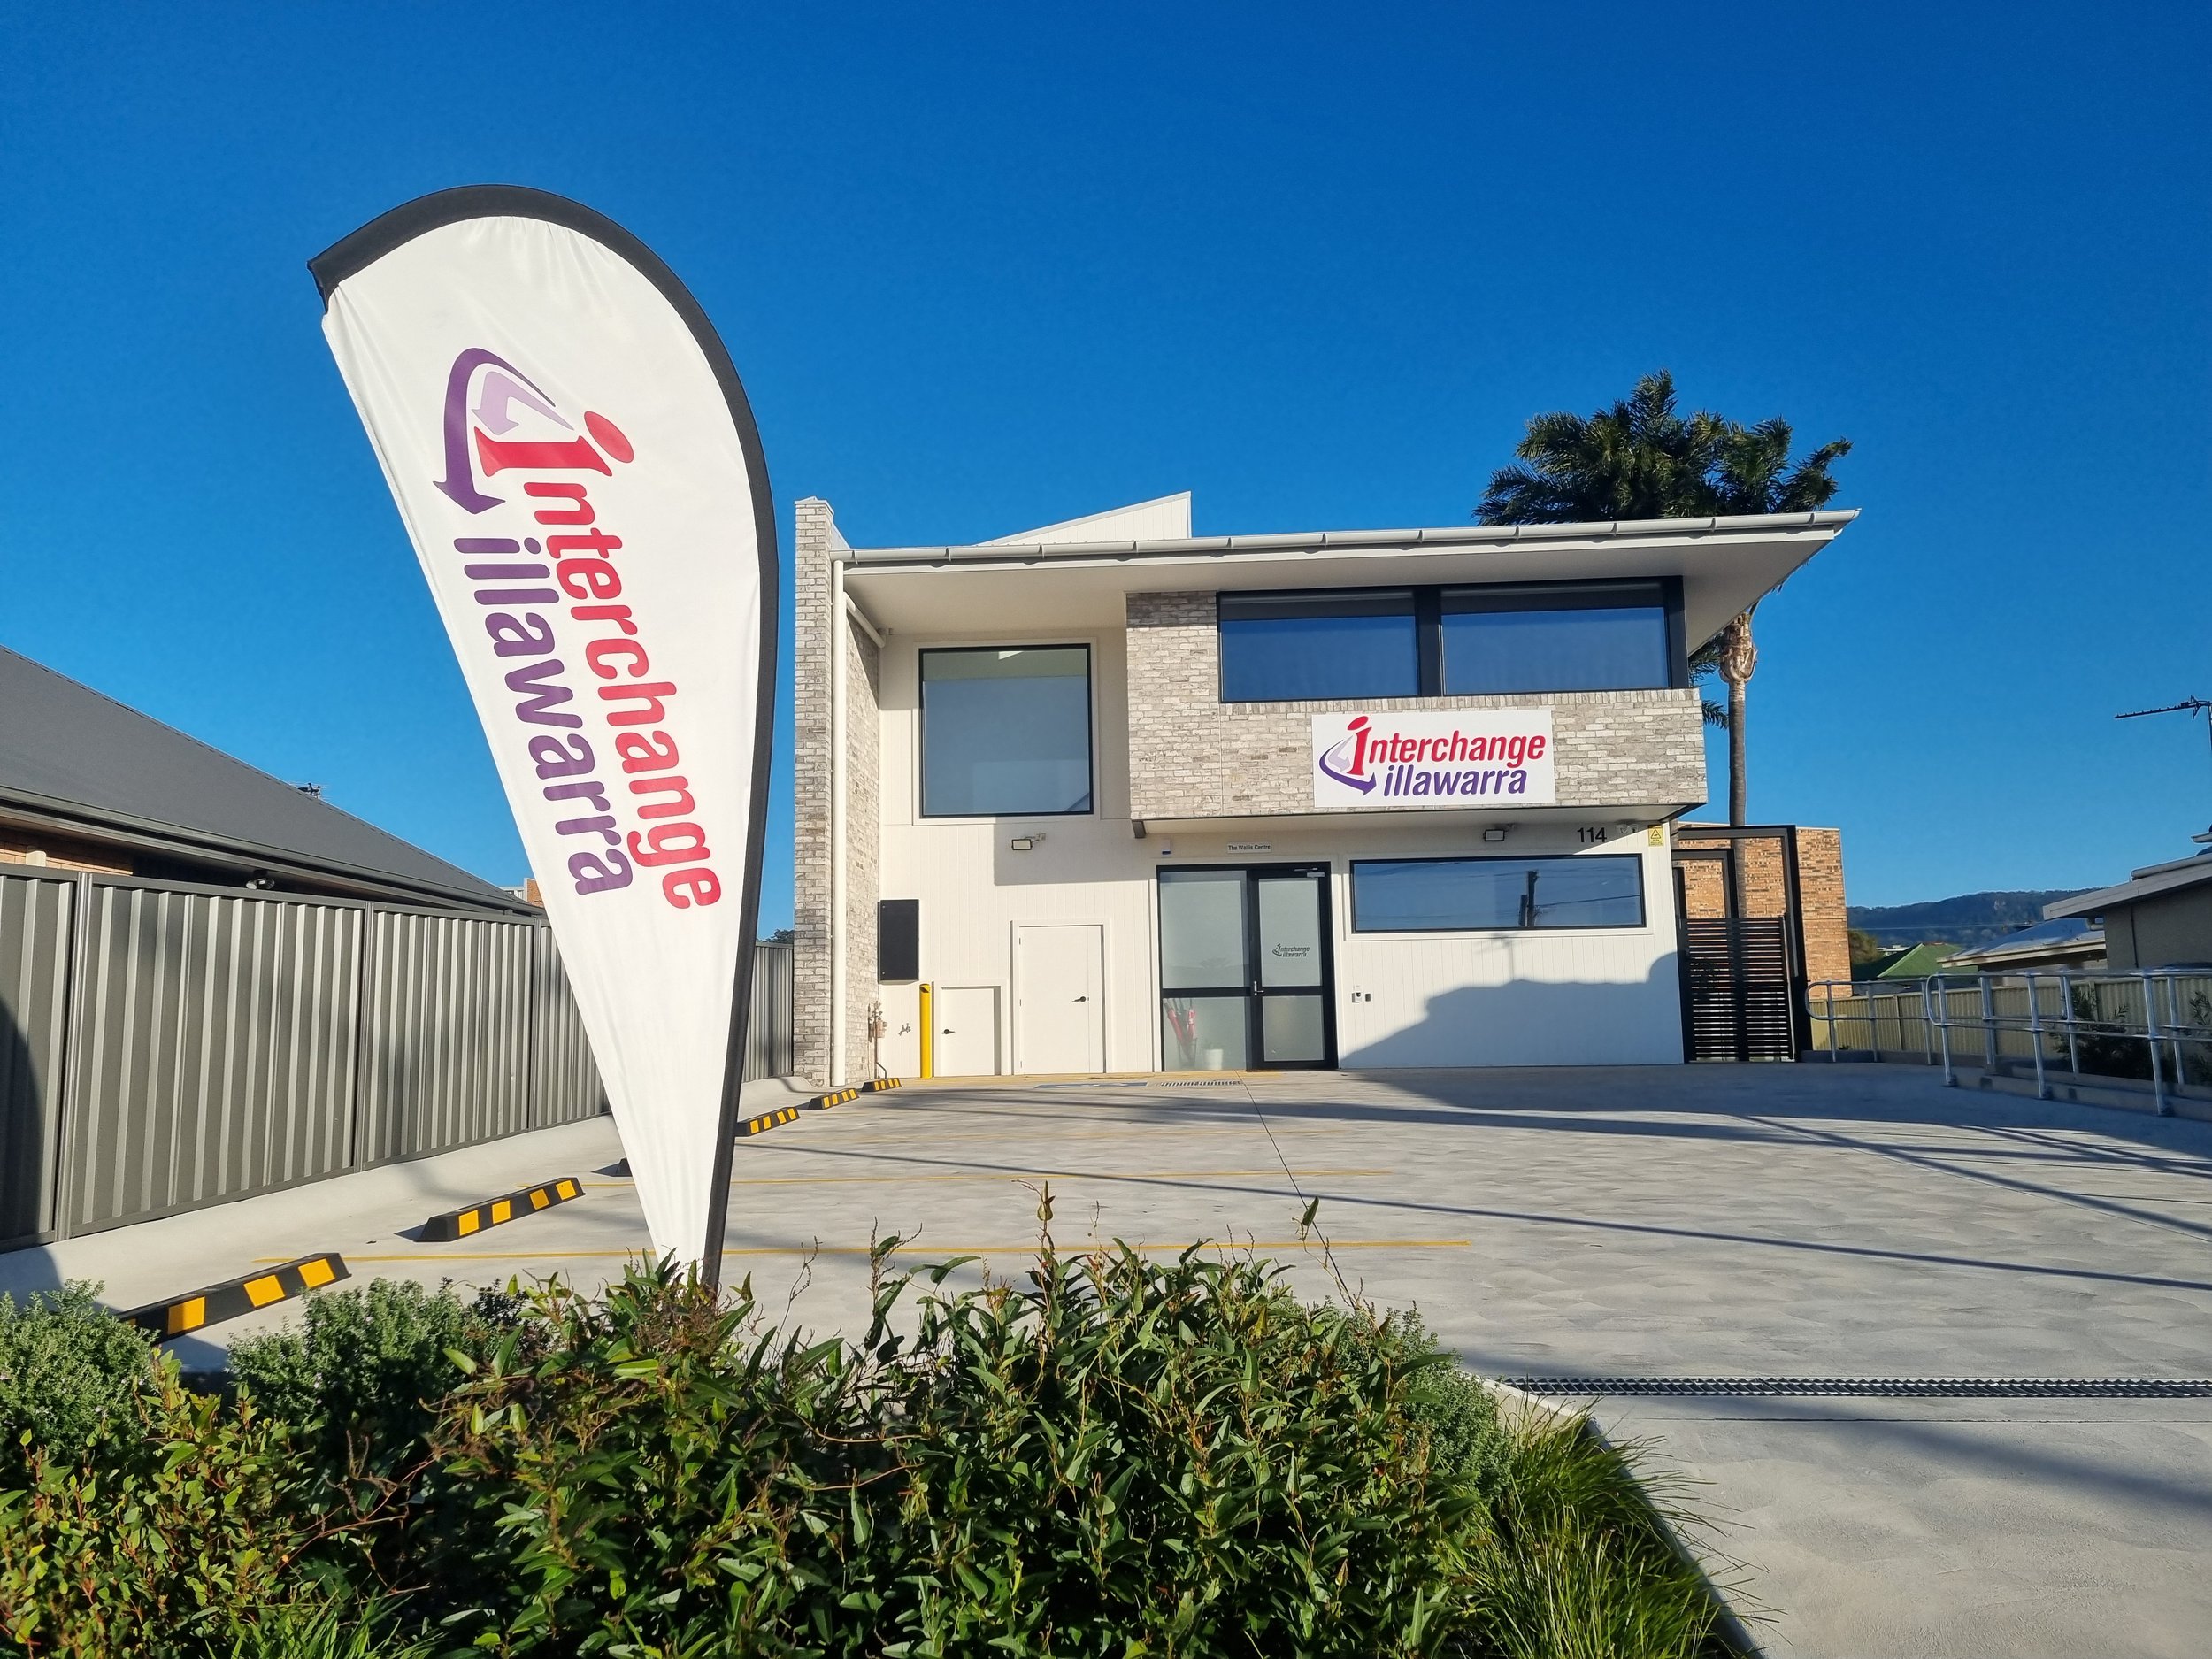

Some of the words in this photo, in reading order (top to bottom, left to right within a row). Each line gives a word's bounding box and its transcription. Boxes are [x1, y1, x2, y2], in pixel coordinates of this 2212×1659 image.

[453, 536, 634, 895] illawarra
[1383, 764, 1528, 796] illawarra
[1577, 826, 1608, 843] 114
